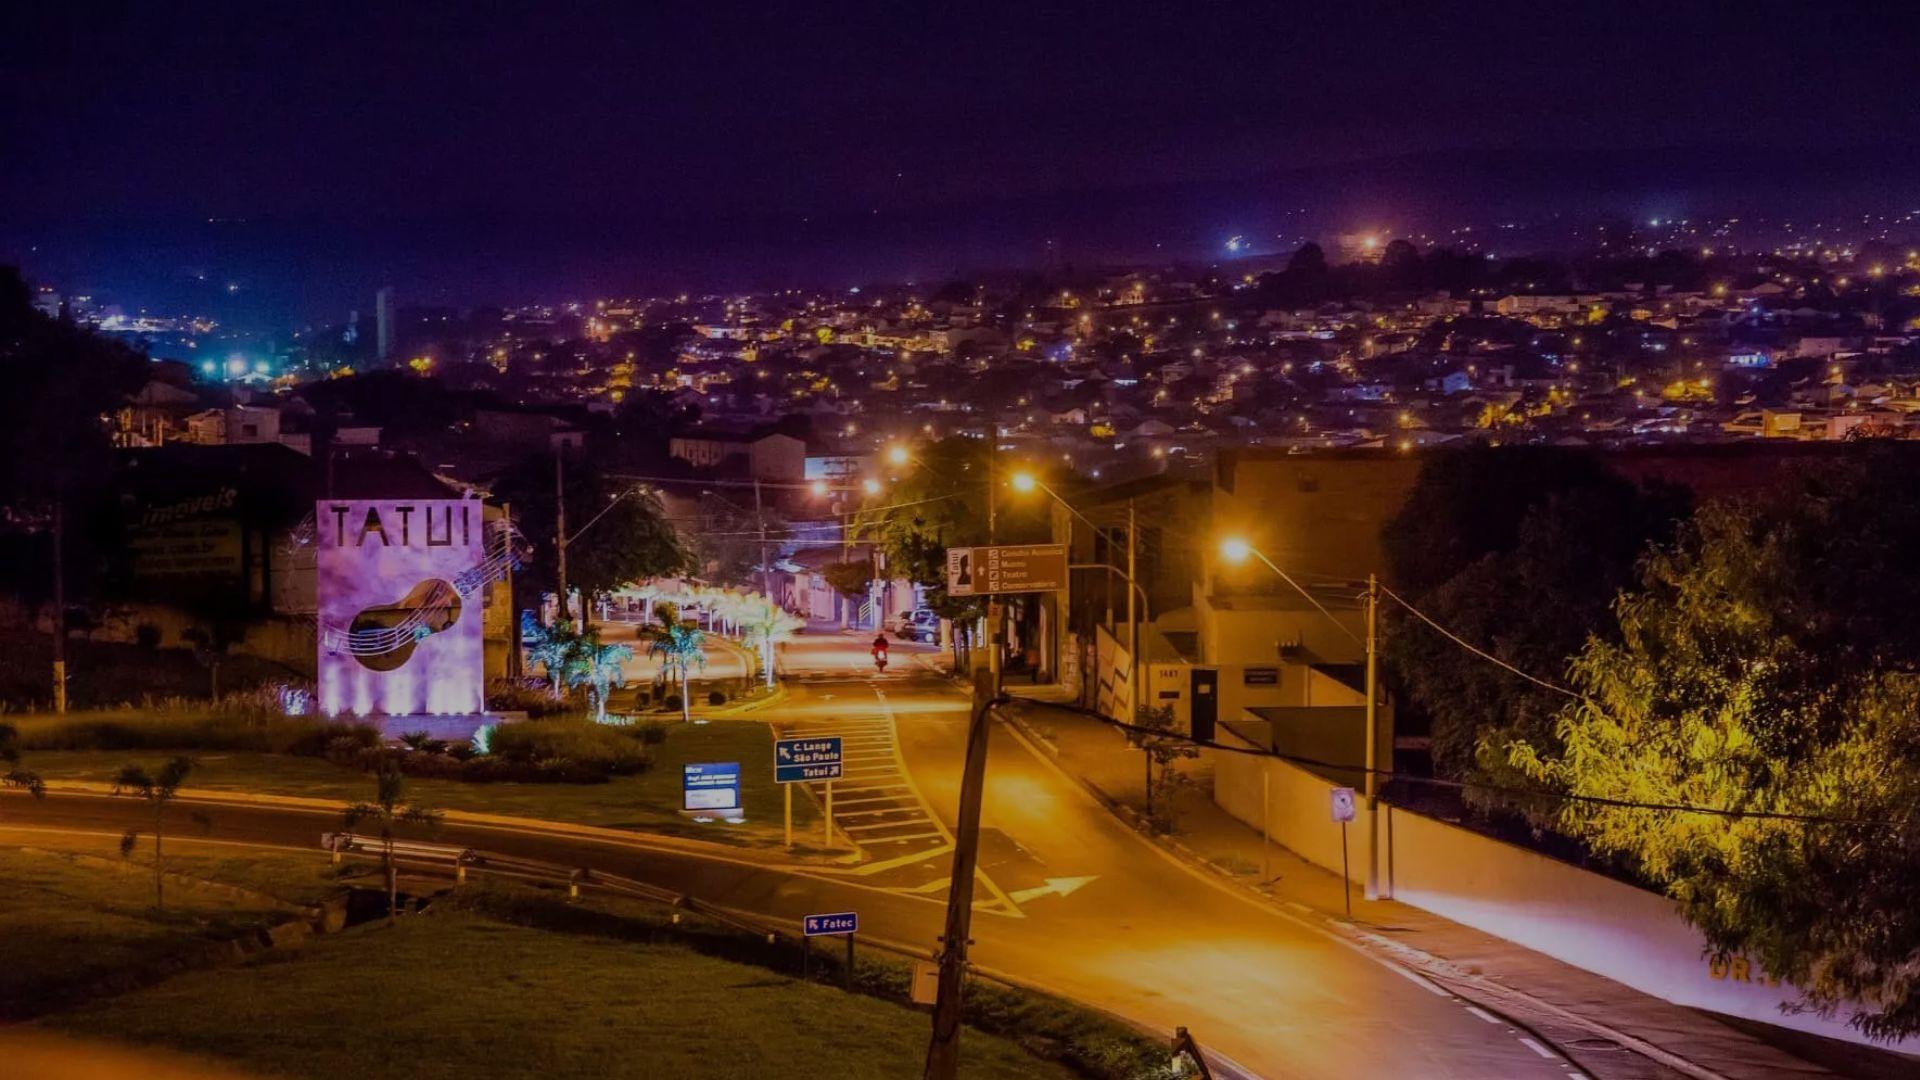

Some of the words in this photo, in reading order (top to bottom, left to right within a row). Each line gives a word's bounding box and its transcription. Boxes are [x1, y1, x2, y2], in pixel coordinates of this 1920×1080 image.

[803, 742, 832, 752] Lange
[793, 752, 811, 762] São
[812, 752, 839, 761] Paulo
[823, 918, 853, 929] Fatec
